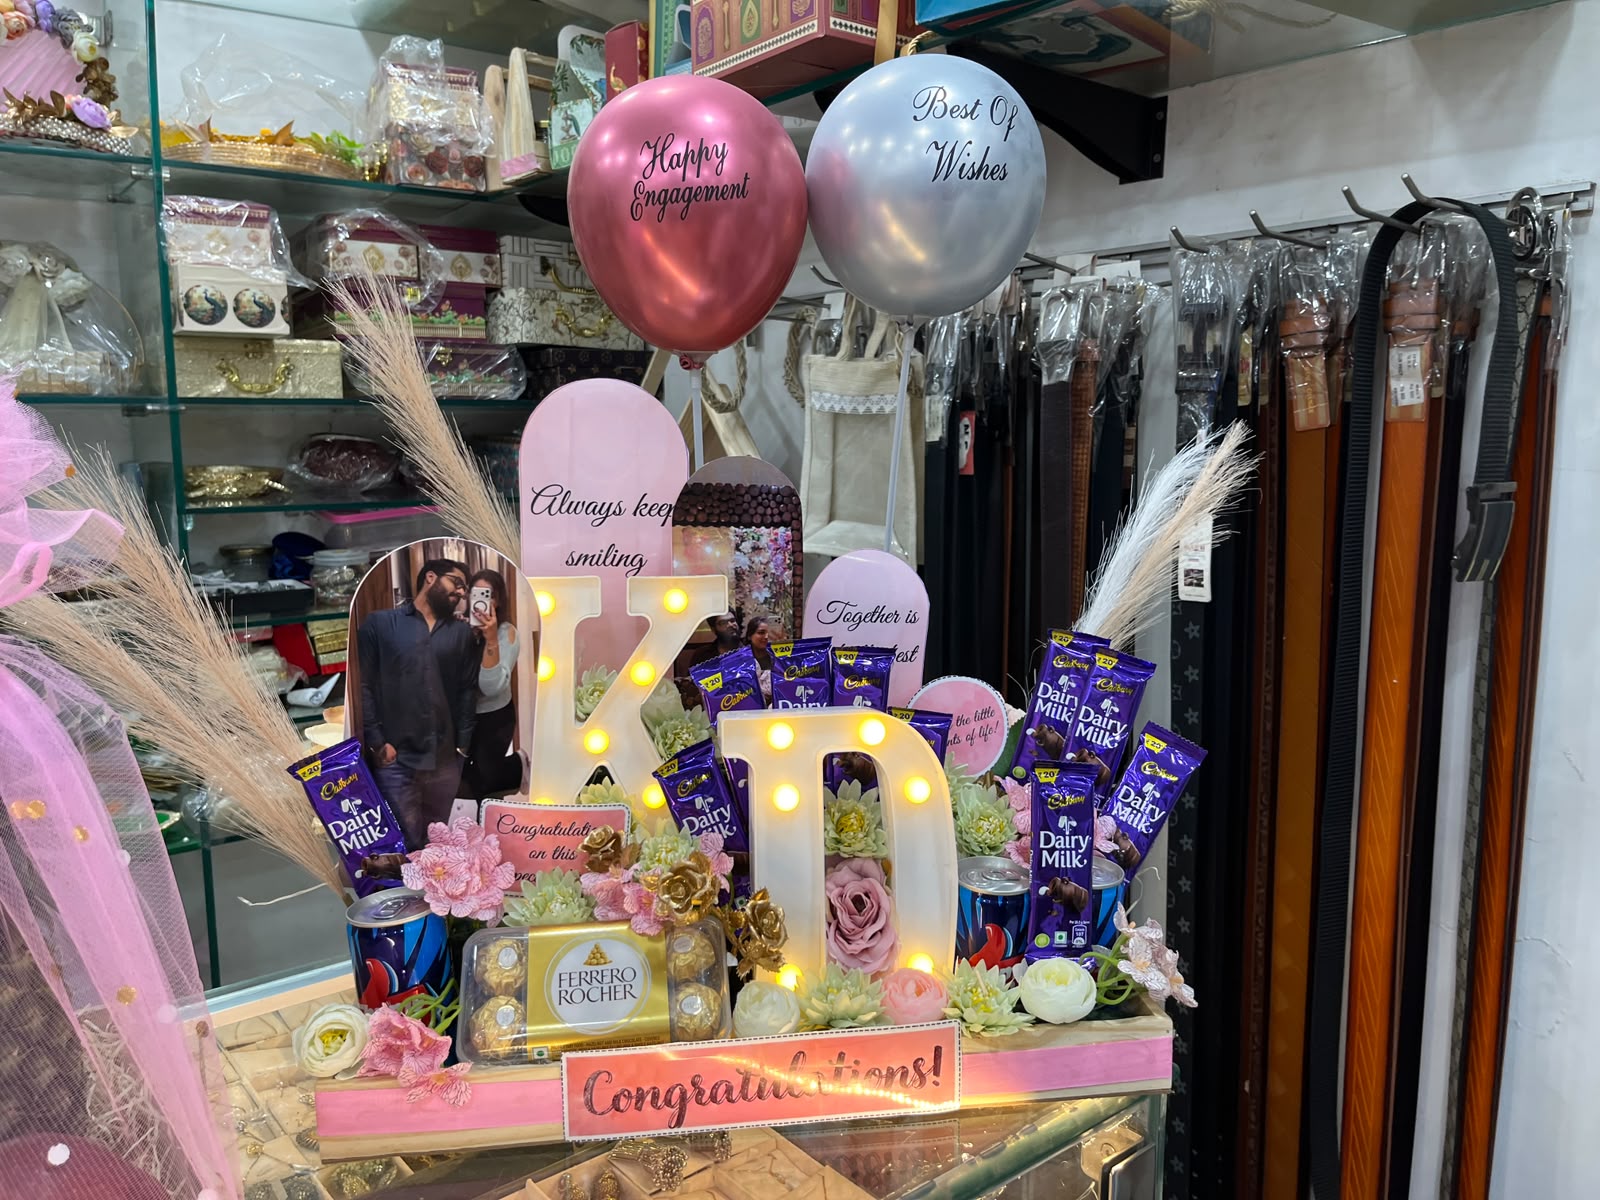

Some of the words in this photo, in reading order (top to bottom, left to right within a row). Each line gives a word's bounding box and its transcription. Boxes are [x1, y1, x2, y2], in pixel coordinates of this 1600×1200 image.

[912, 85, 984, 122] Best
[989, 95, 1019, 142] Of
[639, 132, 729, 182] Happy
[925, 140, 1009, 183] Wishes
[630, 172, 751, 223] Engagement
[530, 483, 628, 528] Always
[565, 543, 649, 579] smiling
[816, 600, 901, 632] Together
[904, 610, 920, 624] is
[893, 644, 920, 663] est
[1052, 654, 1090, 672] Cadbury
[1036, 681, 1079, 712] Dairy
[1096, 677, 1134, 696] Cadbury
[956, 714, 971, 727] the
[973, 706, 995, 722] little
[1034, 697, 1075, 724] Milk
[1078, 705, 1129, 737] Dairy
[965, 727, 976, 747] of
[978, 720, 999, 743] life!
[1075, 722, 1120, 749] Milk
[320, 773, 359, 801] Cadbury
[1047, 793, 1086, 810] Cadbury
[1111, 801, 1154, 834] Milk
[1118, 784, 1166, 822] Dairy
[327, 804, 382, 840] Dairy
[496, 813, 598, 842] Congratulati
[682, 803, 731, 834] Dairy
[338, 825, 389, 856] Milk
[528, 848, 548, 860] on
[551, 846, 577, 860] this
[1039, 830, 1090, 853] Dairy
[1041, 849, 1088, 868] Milk
[558, 966, 637, 989] FERRERO
[558, 983, 639, 1006] ROCHER
[582, 1044, 943, 1130] Congratulations!
